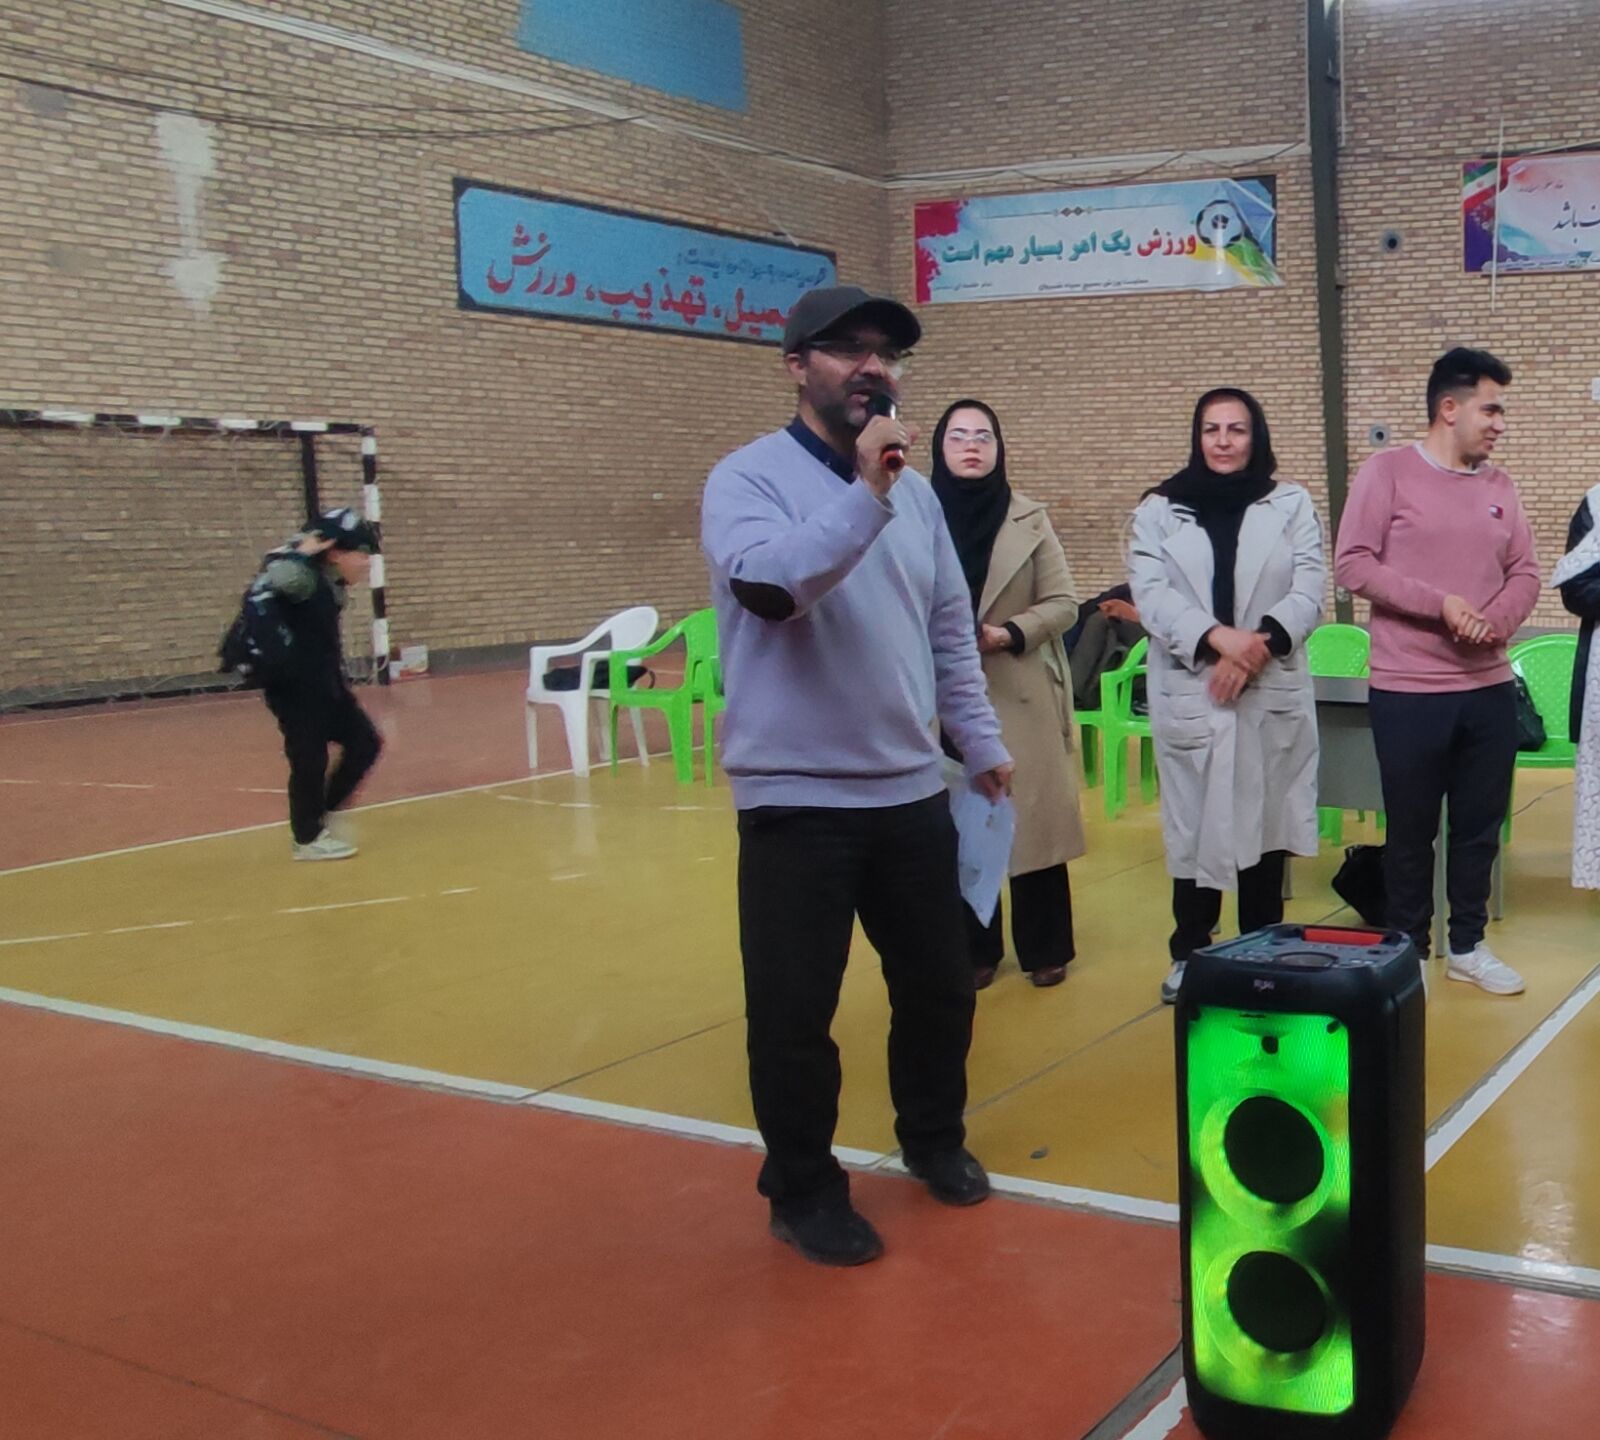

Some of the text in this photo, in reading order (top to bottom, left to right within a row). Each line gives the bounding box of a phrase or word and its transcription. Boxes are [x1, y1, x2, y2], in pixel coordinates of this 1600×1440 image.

[941, 227, 1197, 267] ورزش یک امر بسیار مهم است
[1551, 200, 1579, 245] باشد
[486, 222, 578, 295] ورزش
[585, 266, 708, 326] تهذیب،
